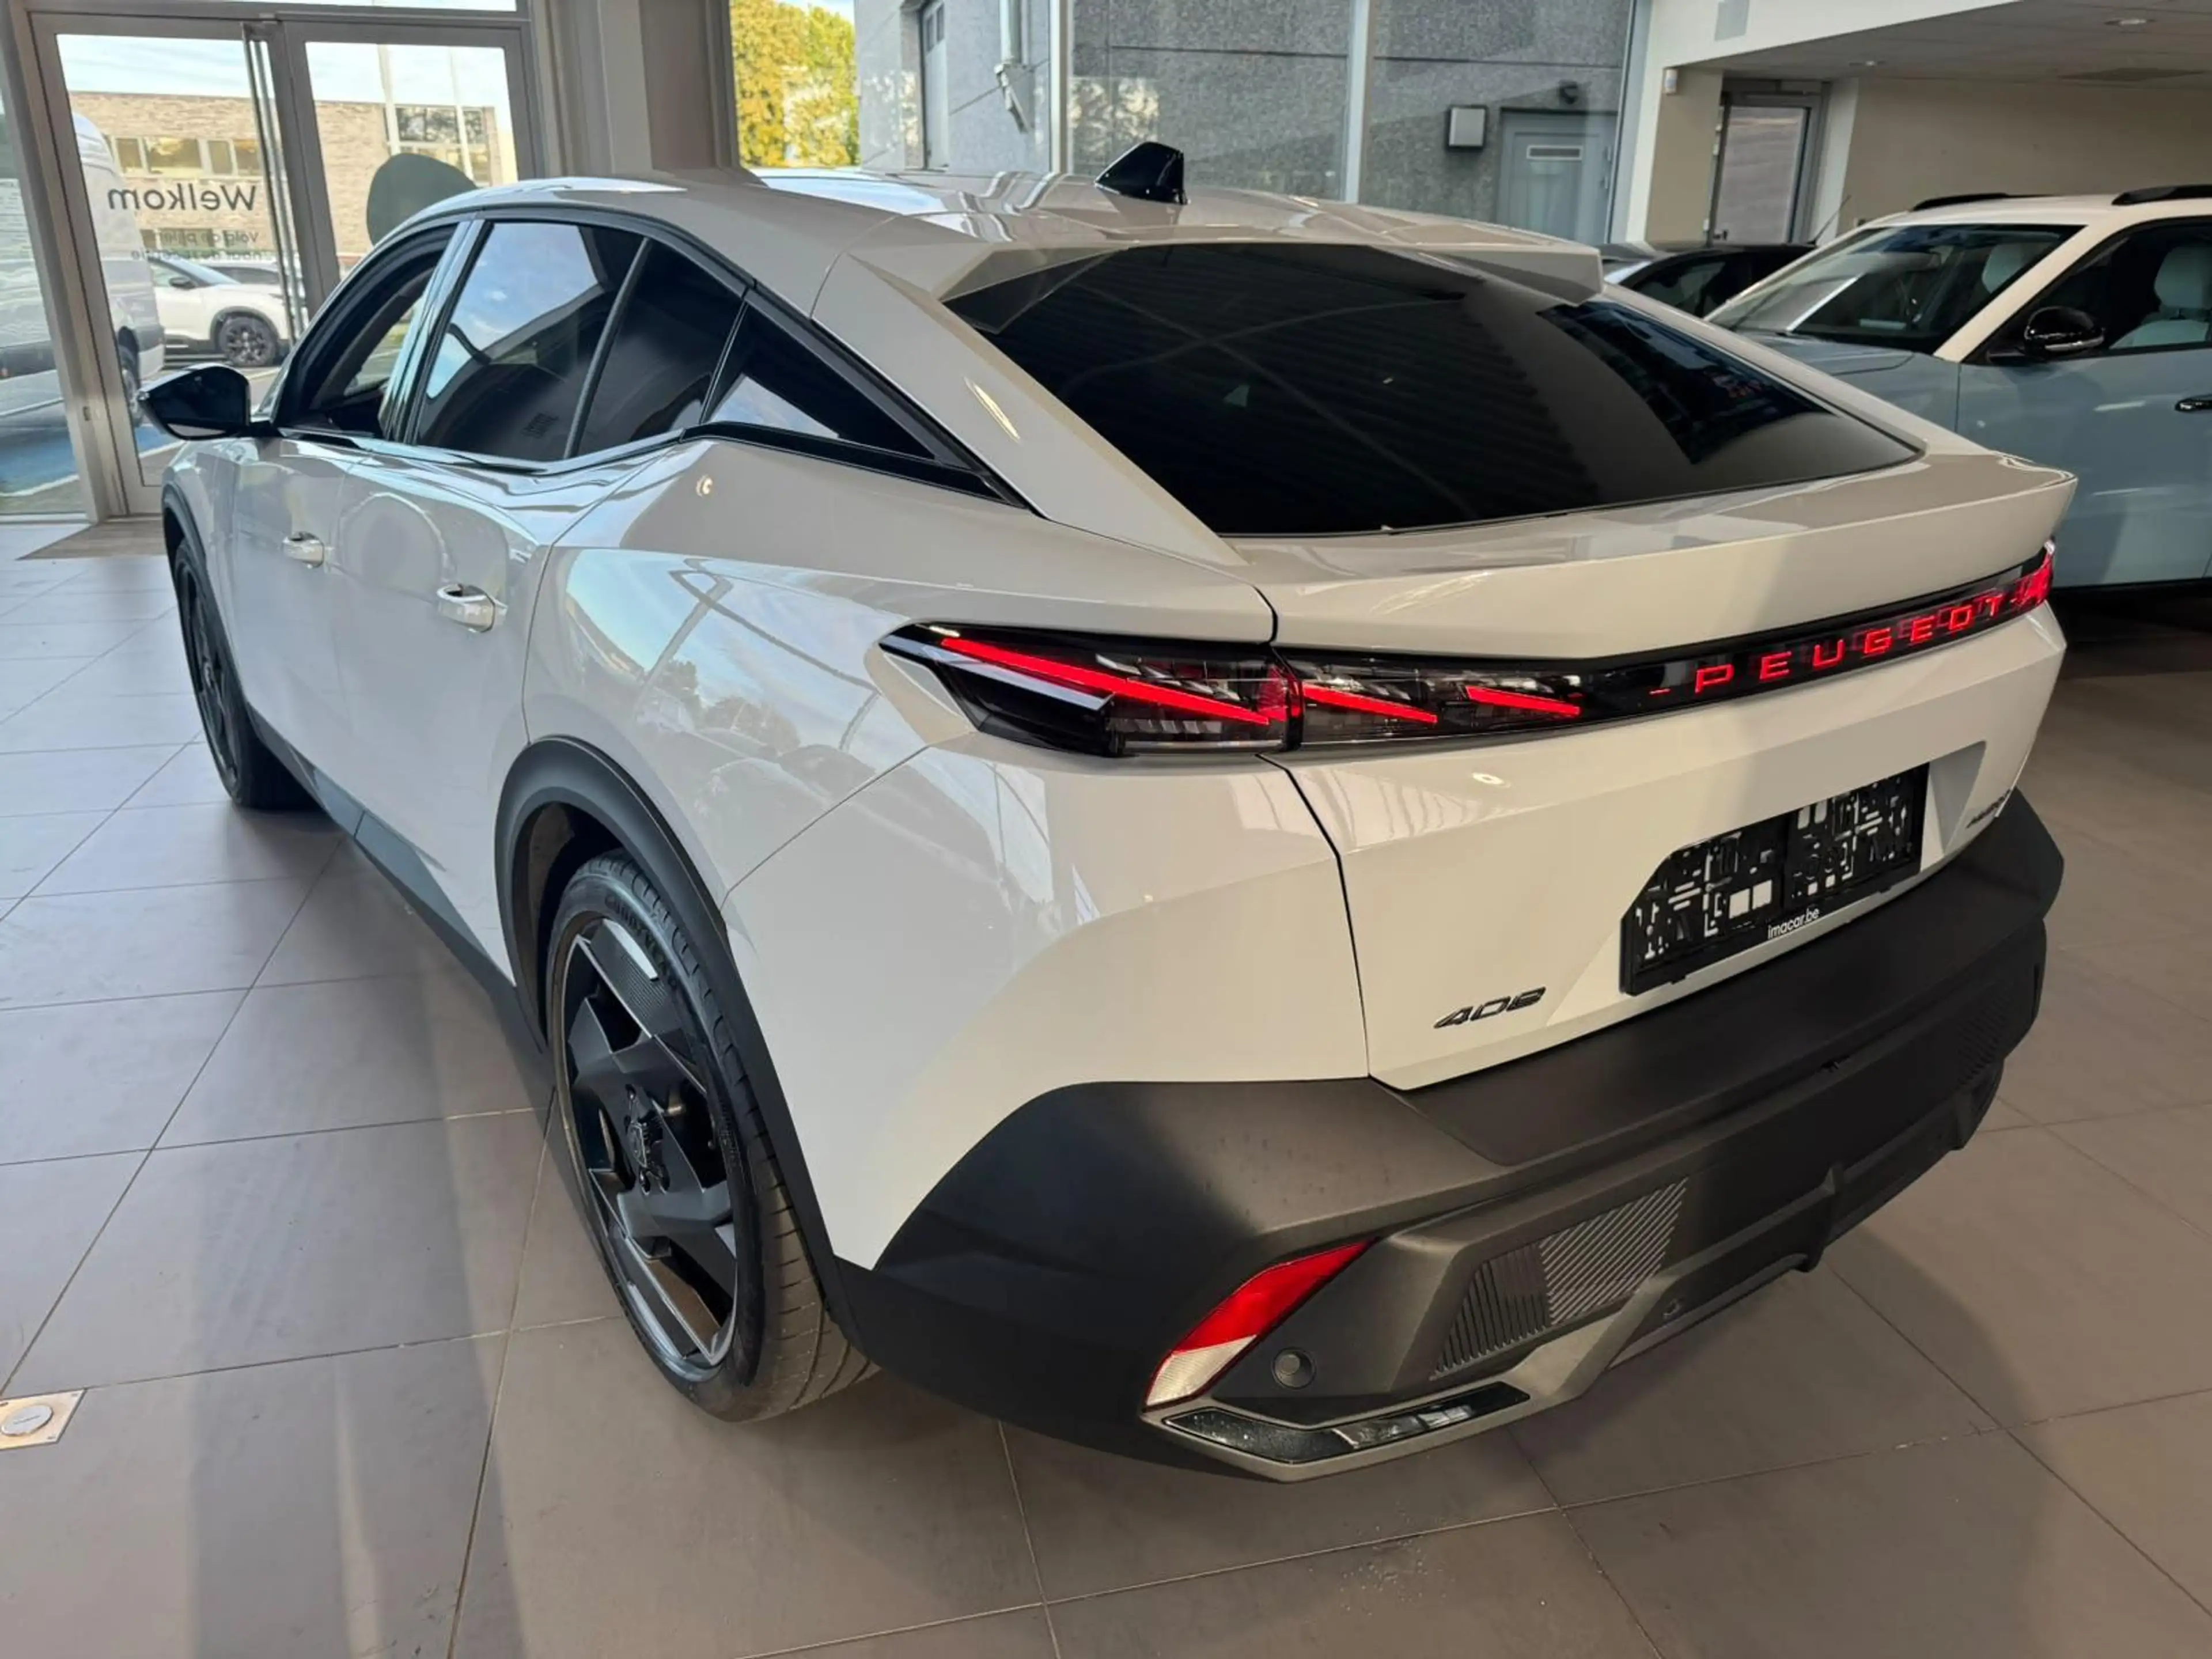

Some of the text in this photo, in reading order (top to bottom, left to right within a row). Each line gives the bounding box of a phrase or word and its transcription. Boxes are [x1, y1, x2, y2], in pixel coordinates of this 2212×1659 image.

[1695, 594, 2003, 694] PEUGEOT
[1767, 907, 1820, 940] imacar.be
[1433, 986, 1547, 1029] 408
